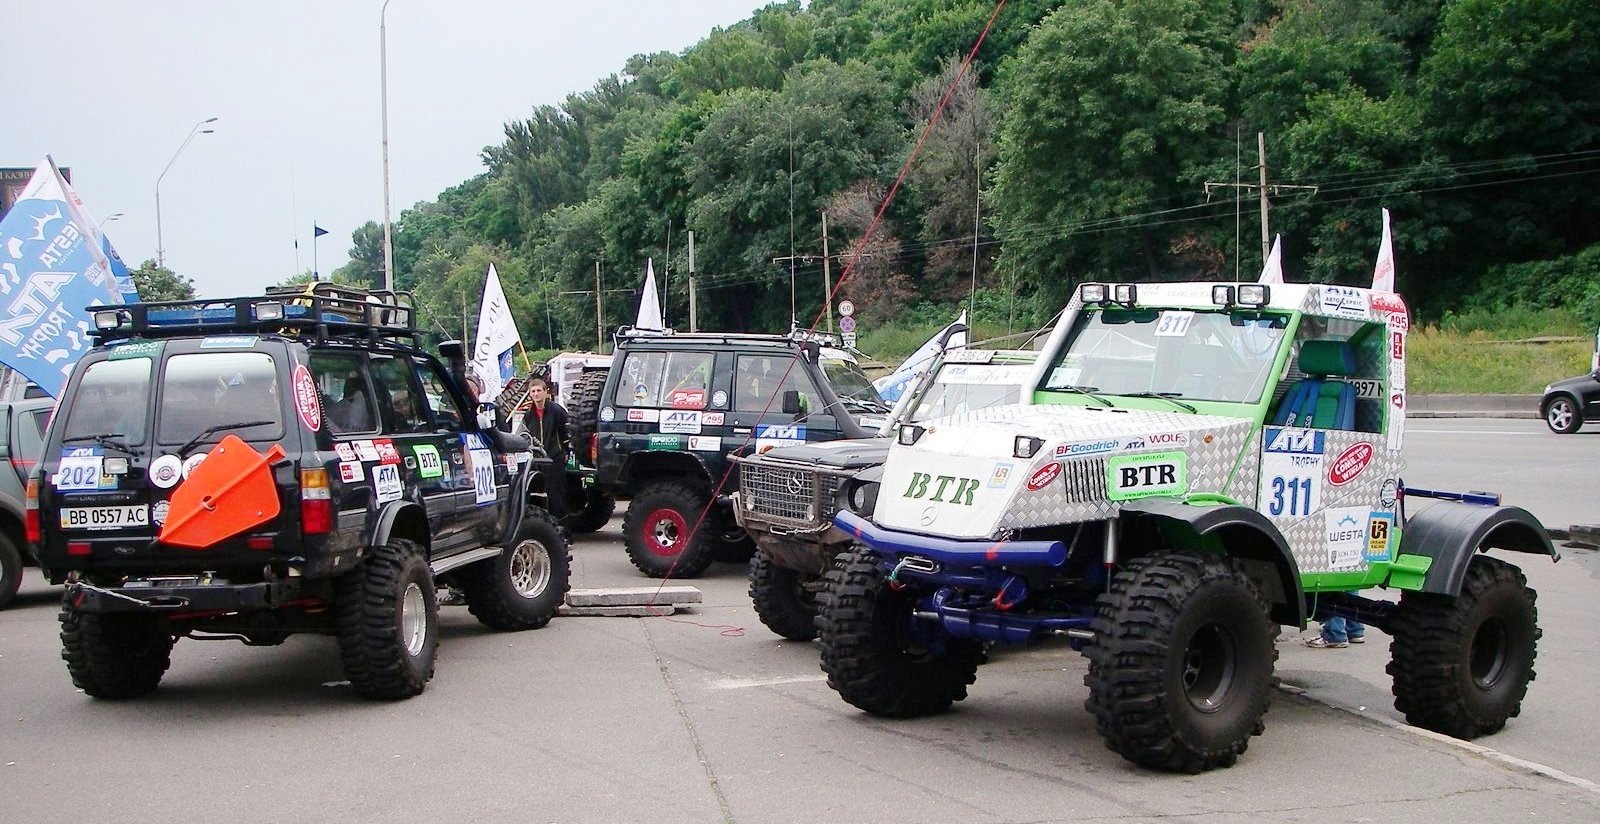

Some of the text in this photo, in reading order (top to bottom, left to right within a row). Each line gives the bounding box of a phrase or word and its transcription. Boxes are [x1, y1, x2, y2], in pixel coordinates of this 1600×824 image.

[1159, 315, 1190, 332] 311
[1056, 440, 1120, 454] BFGoodrich
[1149, 433, 1181, 444] WOLF
[420, 453, 439, 468] BTR
[1290, 456, 1320, 469] TROPHY
[61, 466, 96, 486] 202
[475, 466, 495, 496] 202
[1120, 464, 1176, 488] BTR
[903, 472, 980, 506] BTR
[1269, 477, 1312, 516] 311
[70, 509, 88, 525] BB
[92, 508, 122, 524] 0557
[127, 508, 145, 523] AC
[1329, 530, 1363, 542] WESTA
